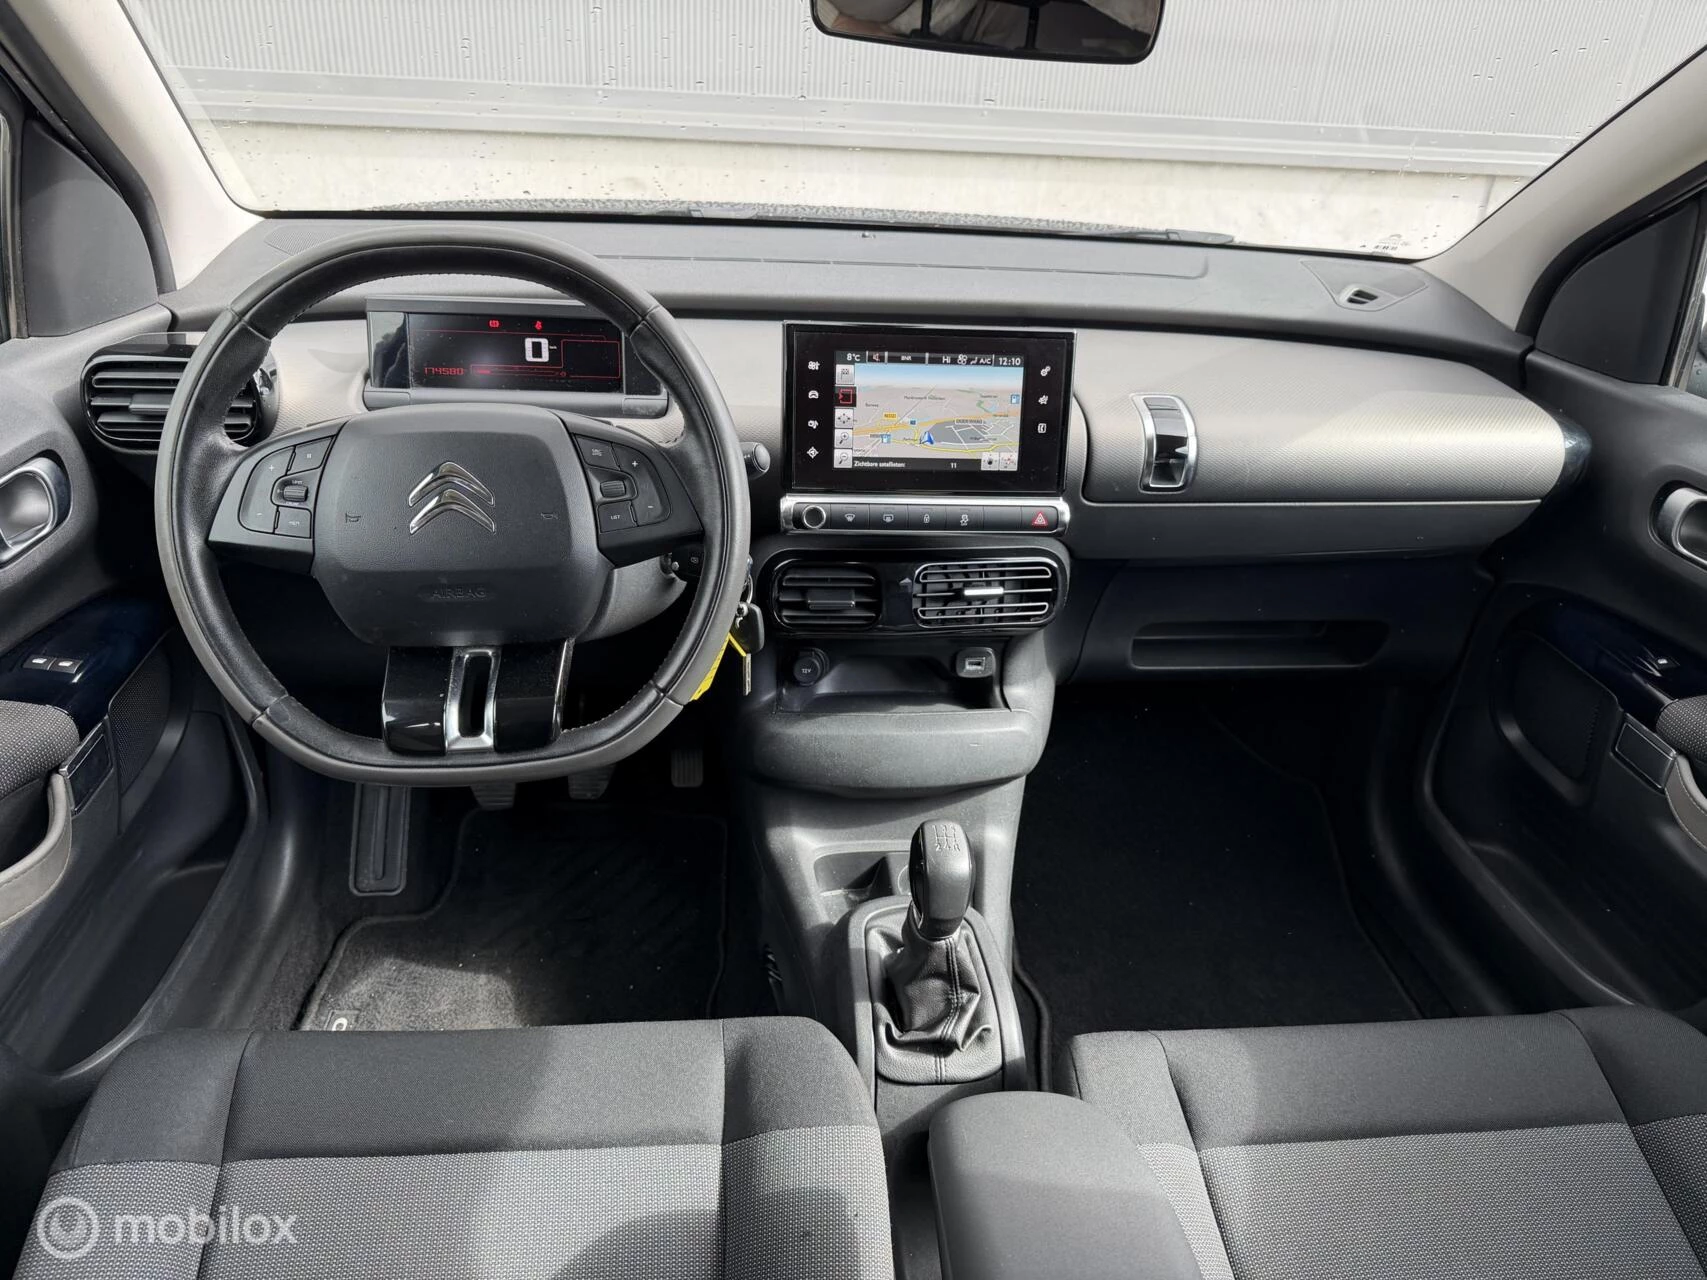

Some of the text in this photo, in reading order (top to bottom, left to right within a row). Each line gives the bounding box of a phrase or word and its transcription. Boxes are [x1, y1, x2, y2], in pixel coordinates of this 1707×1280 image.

[524, 337, 550, 362] 0
[846, 353, 861, 361] 8°C
[999, 357, 1021, 366] 12:10
[424, 366, 464, 376] 174580
[853, 460, 878, 468] Zichtbare
[431, 585, 488, 599] AIRBAG
